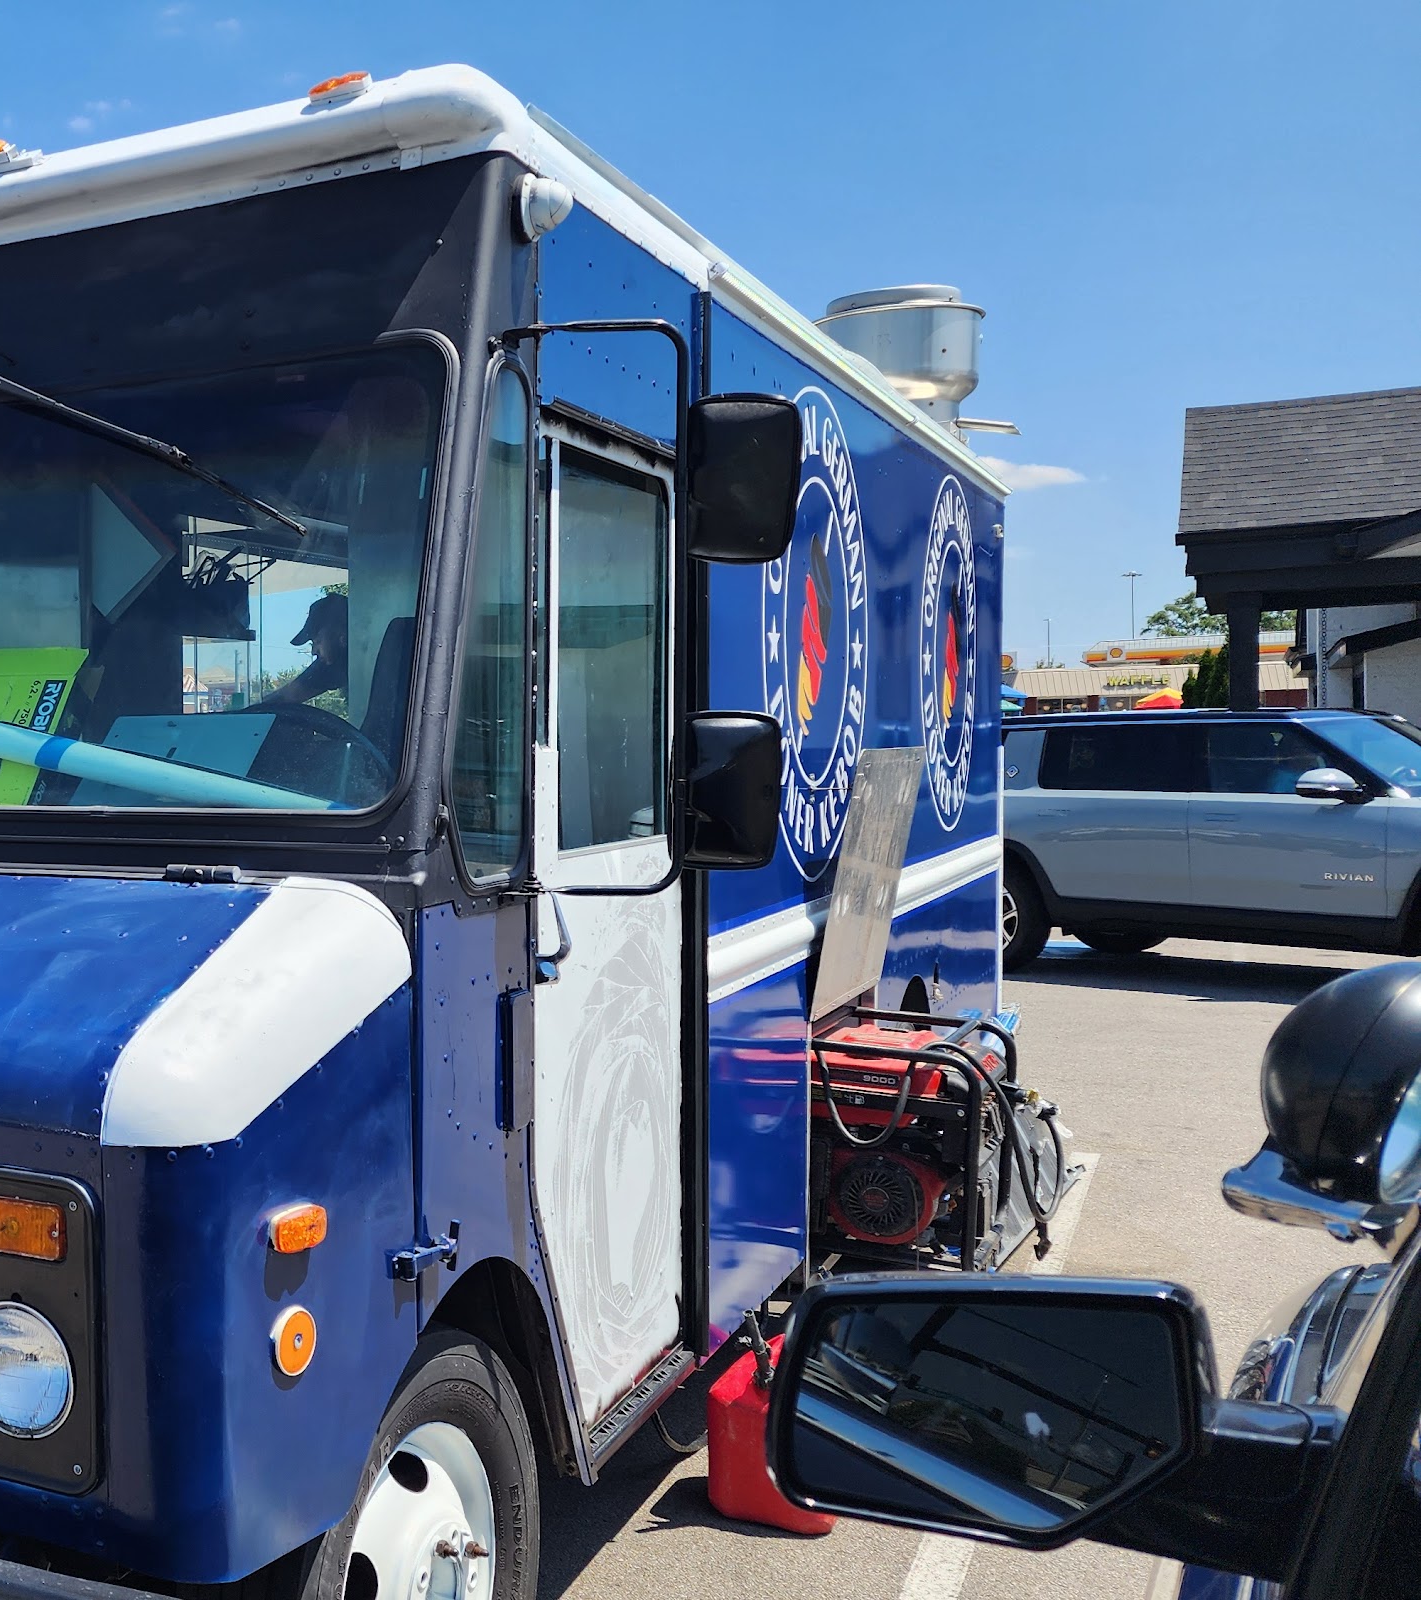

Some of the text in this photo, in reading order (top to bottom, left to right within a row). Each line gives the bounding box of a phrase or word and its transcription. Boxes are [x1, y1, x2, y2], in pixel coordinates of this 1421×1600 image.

[822, 416, 864, 611] GERMAN
[924, 488, 955, 628] ORIGINAL
[955, 495, 975, 636] GERMAN
[31, 682, 63, 731] RYOBI
[1107, 673, 1171, 686] WAFFLE
[819, 684, 862, 848] KEBOB
[924, 691, 973, 817] DÖNER KEBOB
[1324, 872, 1374, 882] RIVIAN
